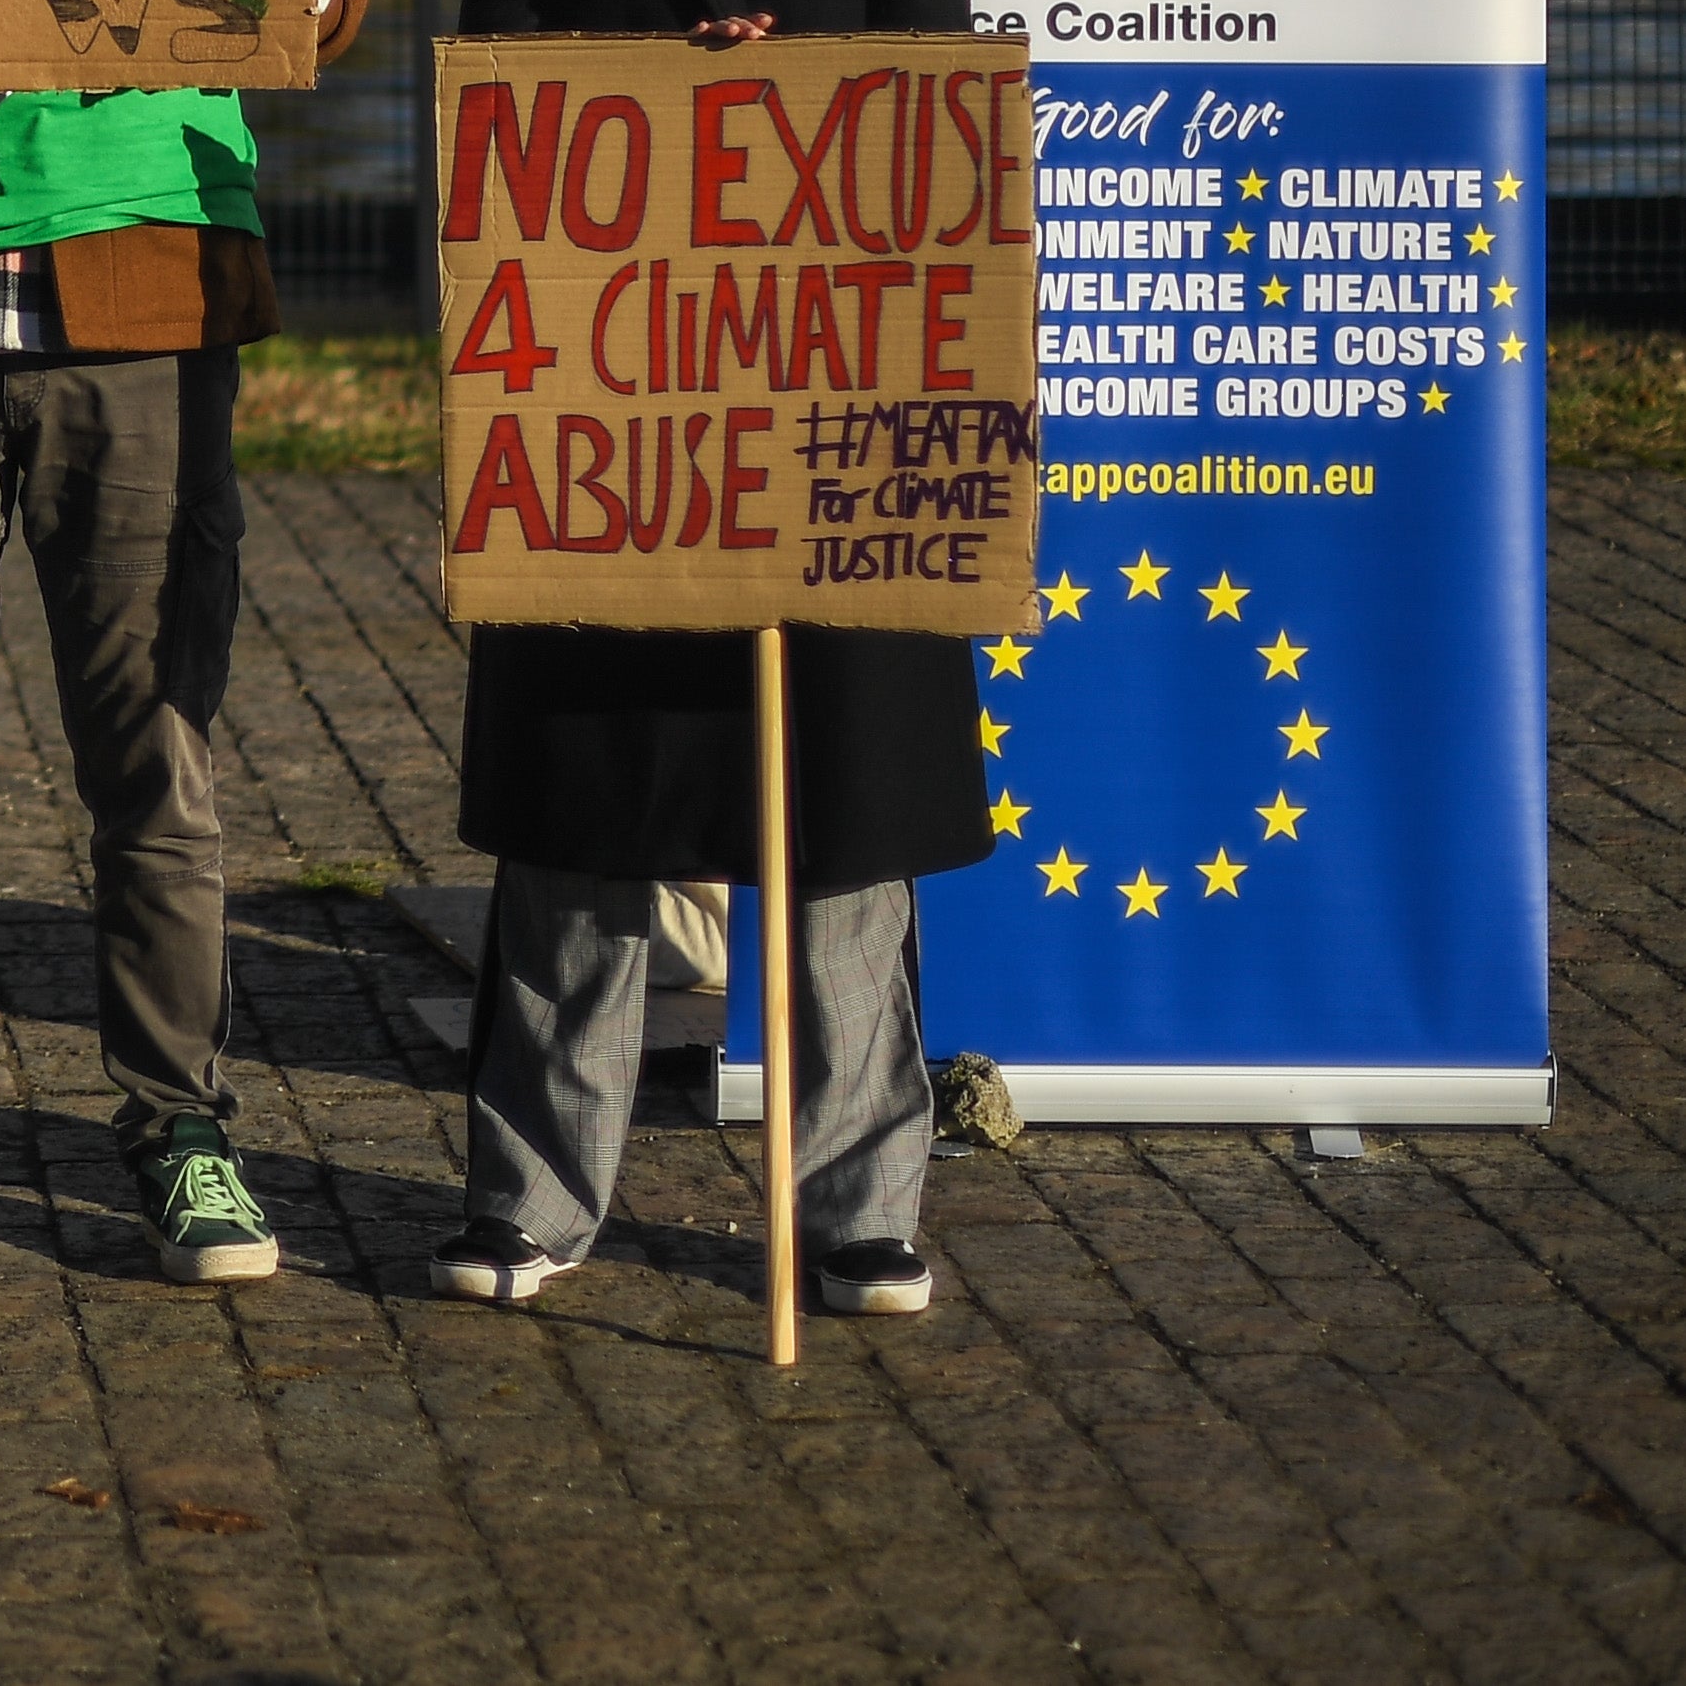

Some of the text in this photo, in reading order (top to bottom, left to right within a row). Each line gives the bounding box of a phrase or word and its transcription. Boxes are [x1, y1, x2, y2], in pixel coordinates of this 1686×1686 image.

[1045, 1, 1278, 43] Coalition
[1182, 89, 1285, 160] for:
[441, 67, 1032, 255] NO EXCUSE
[1038, 168, 1482, 210] INCOME CLIMATE
[1267, 222, 1453, 262] NATURE
[1037, 273, 1479, 314] WELFARE HEALTH
[448, 258, 559, 395] 4
[1191, 326, 1318, 366] CARE
[1334, 326, 1487, 366] COSTS
[1215, 377, 1407, 419] GROUPS
[452, 407, 779, 555] ABUSE
[801, 531, 989, 587] JUSTICE
